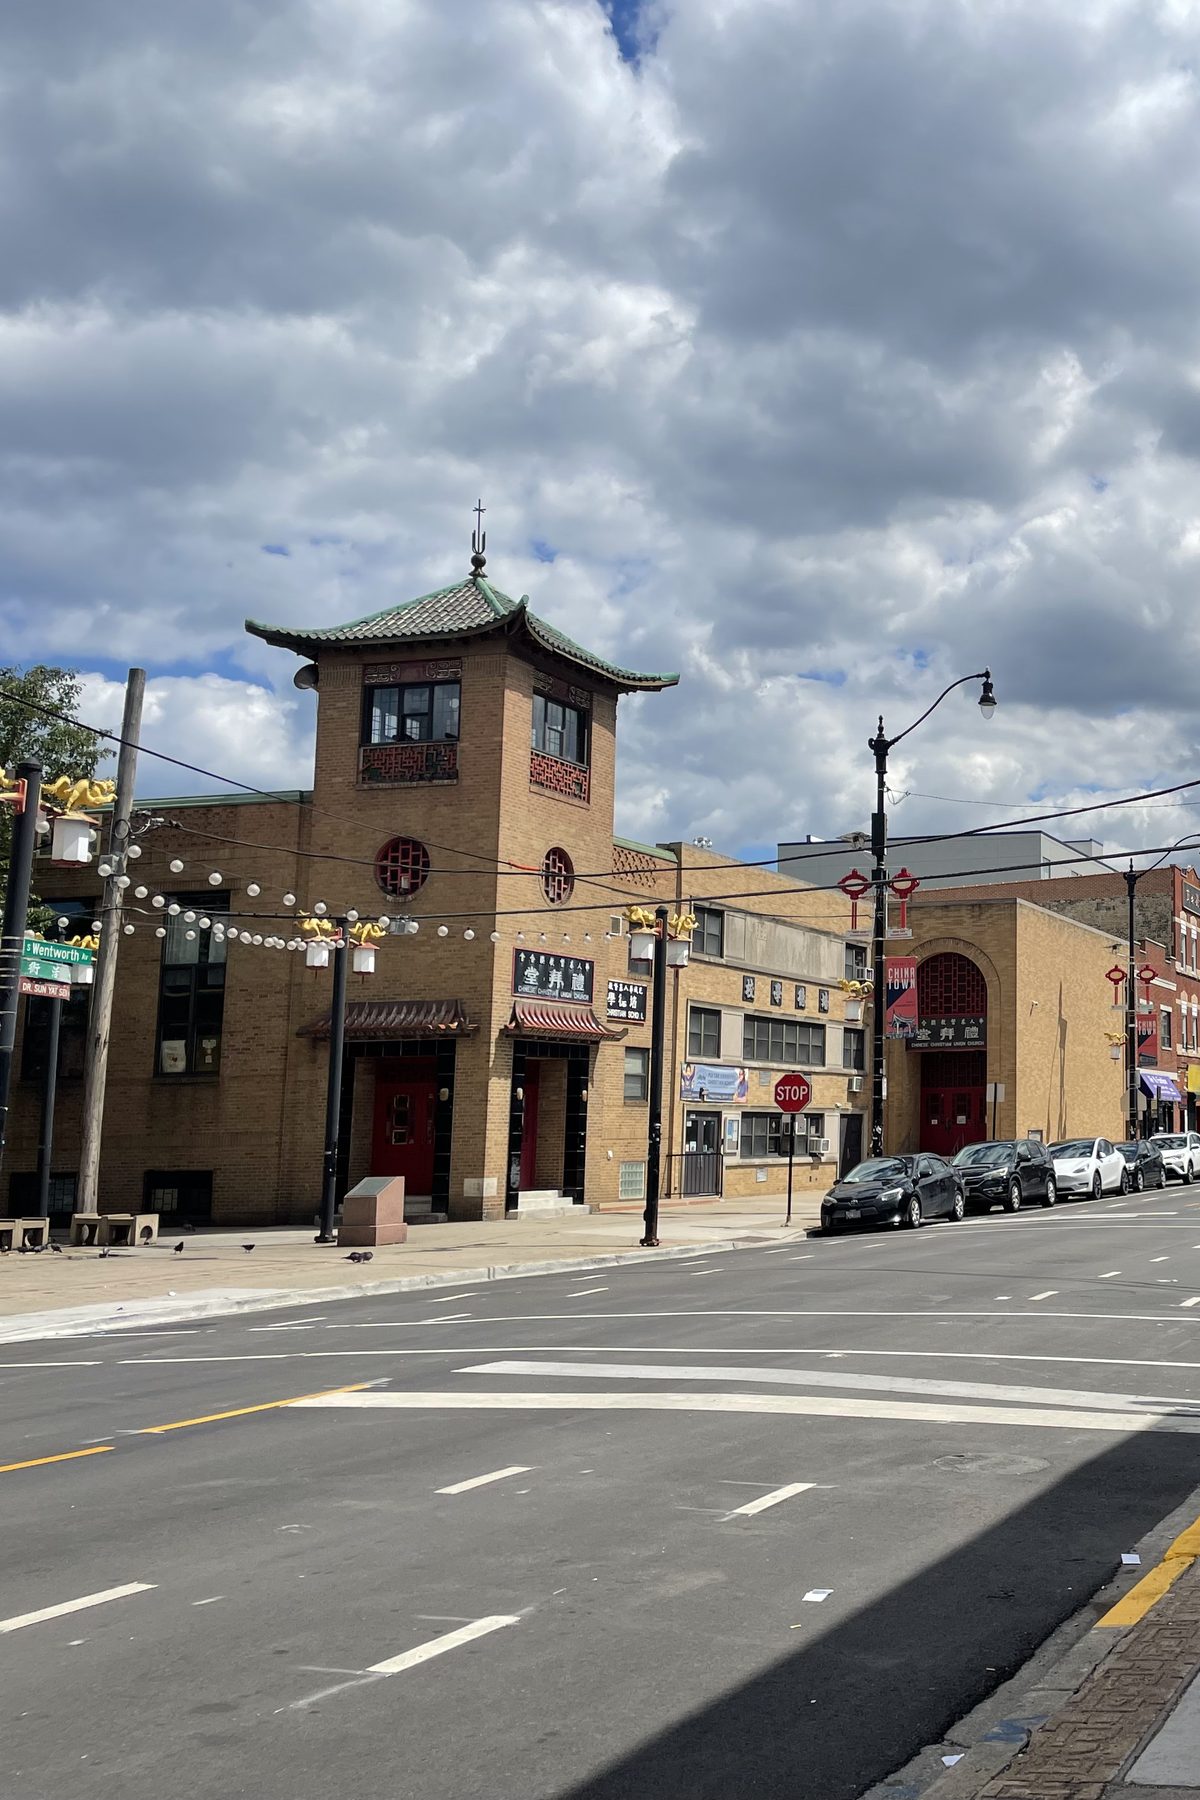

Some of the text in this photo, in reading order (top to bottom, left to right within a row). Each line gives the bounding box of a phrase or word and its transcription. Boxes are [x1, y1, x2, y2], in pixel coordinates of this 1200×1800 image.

[32, 942, 80, 961] Wentworth
[888, 967, 915, 979] CHINA
[33, 984, 47, 994] SUN
[888, 978, 916, 990] TOWN
[776, 1086, 808, 1101] STOP
